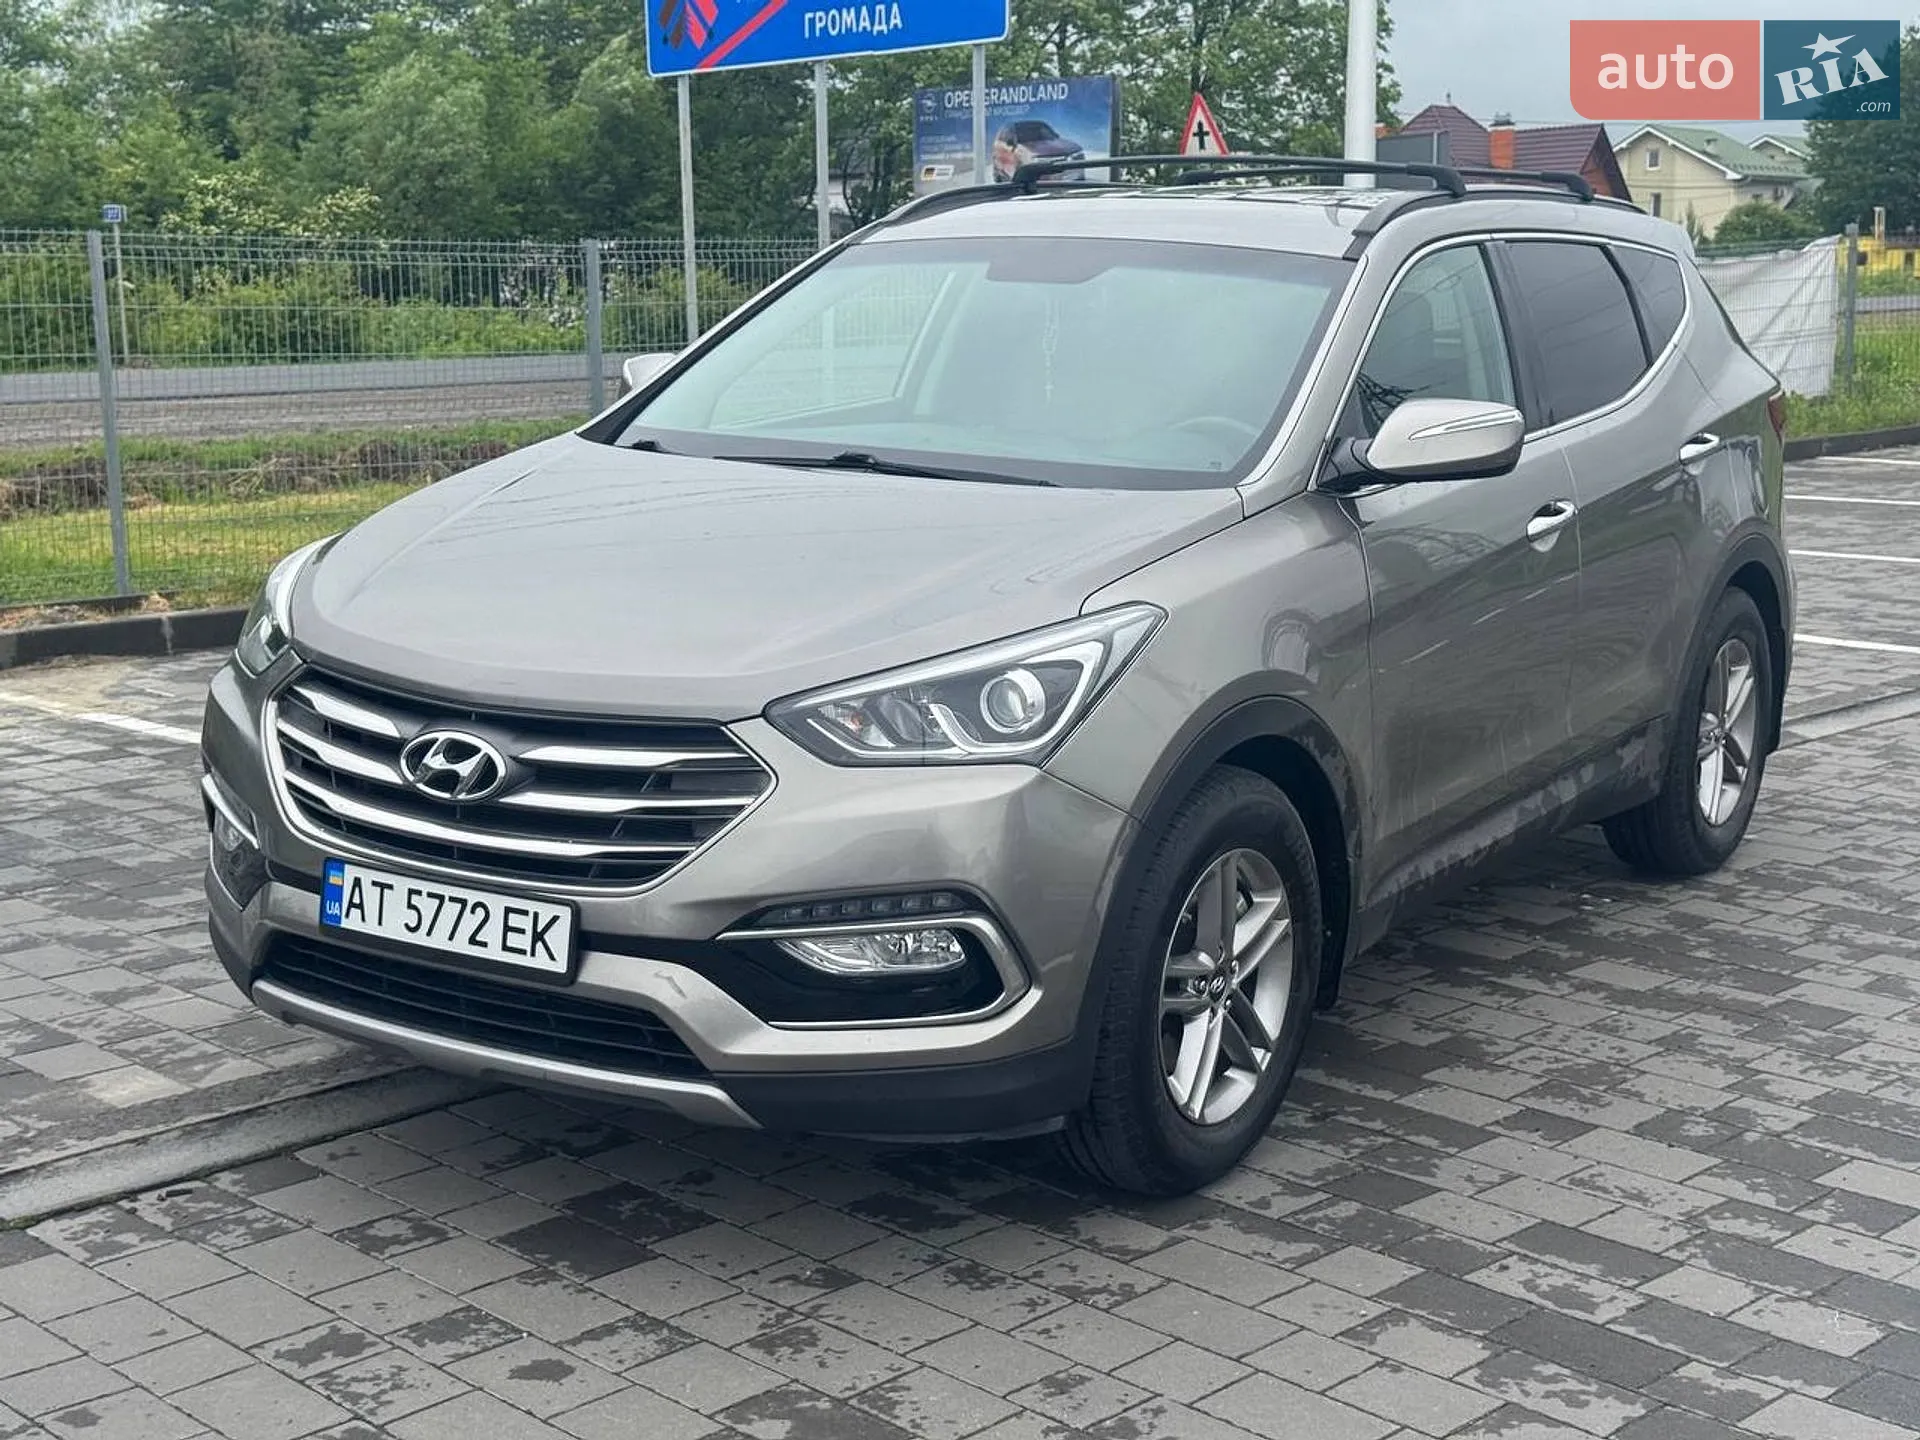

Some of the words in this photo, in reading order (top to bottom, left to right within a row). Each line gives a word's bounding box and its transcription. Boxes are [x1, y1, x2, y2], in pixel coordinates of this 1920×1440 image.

[803, 2, 903, 39] ГРОМАДА
[326, 899, 341, 916] UA
[344, 876, 394, 926] AT
[404, 887, 491, 949] 5772
[501, 906, 561, 962] EK
